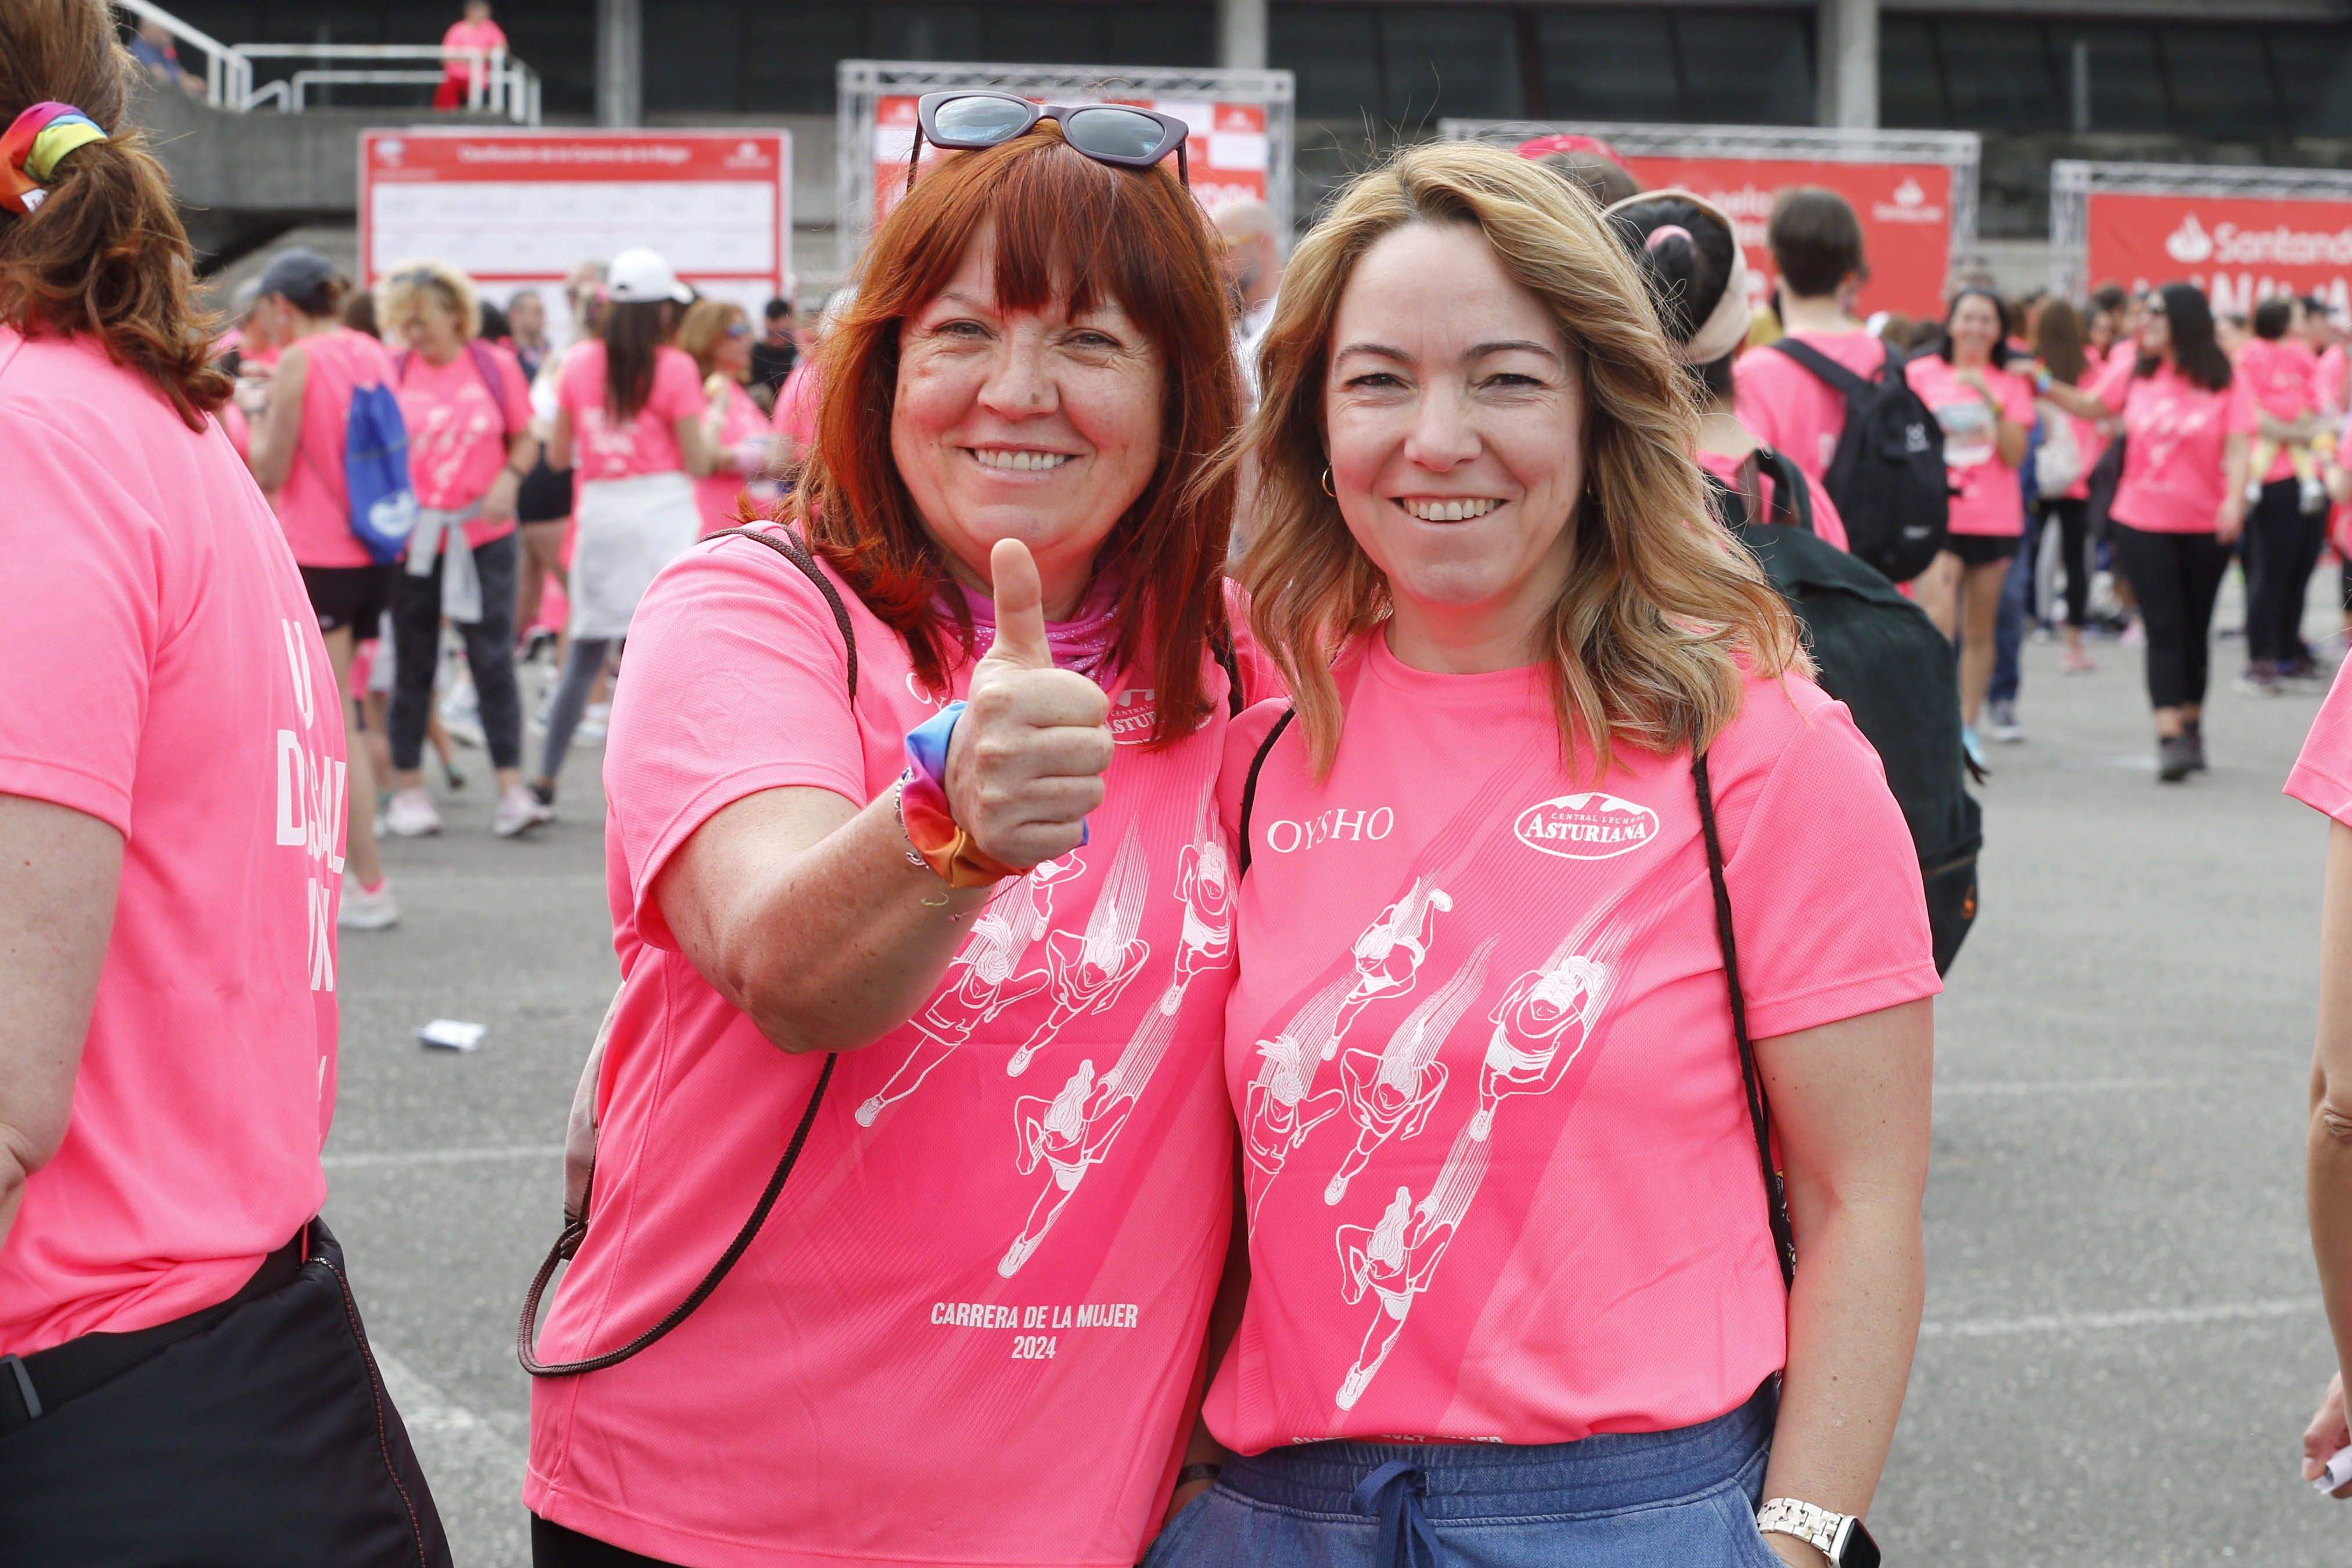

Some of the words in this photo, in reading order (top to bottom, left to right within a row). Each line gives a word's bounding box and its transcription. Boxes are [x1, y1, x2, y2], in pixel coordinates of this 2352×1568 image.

[1267, 806, 1394, 853] OYSHO
[1524, 812, 1646, 842] ASTURIANA
[1551, 812, 1598, 822] CENTRAL
[931, 1302, 1018, 1328] CARRERA
[1023, 1306, 1049, 1328] DE
[1052, 1306, 1072, 1328] LA
[1077, 1304, 1139, 1328] MUJER
[1011, 1336, 1057, 1359] 2024
